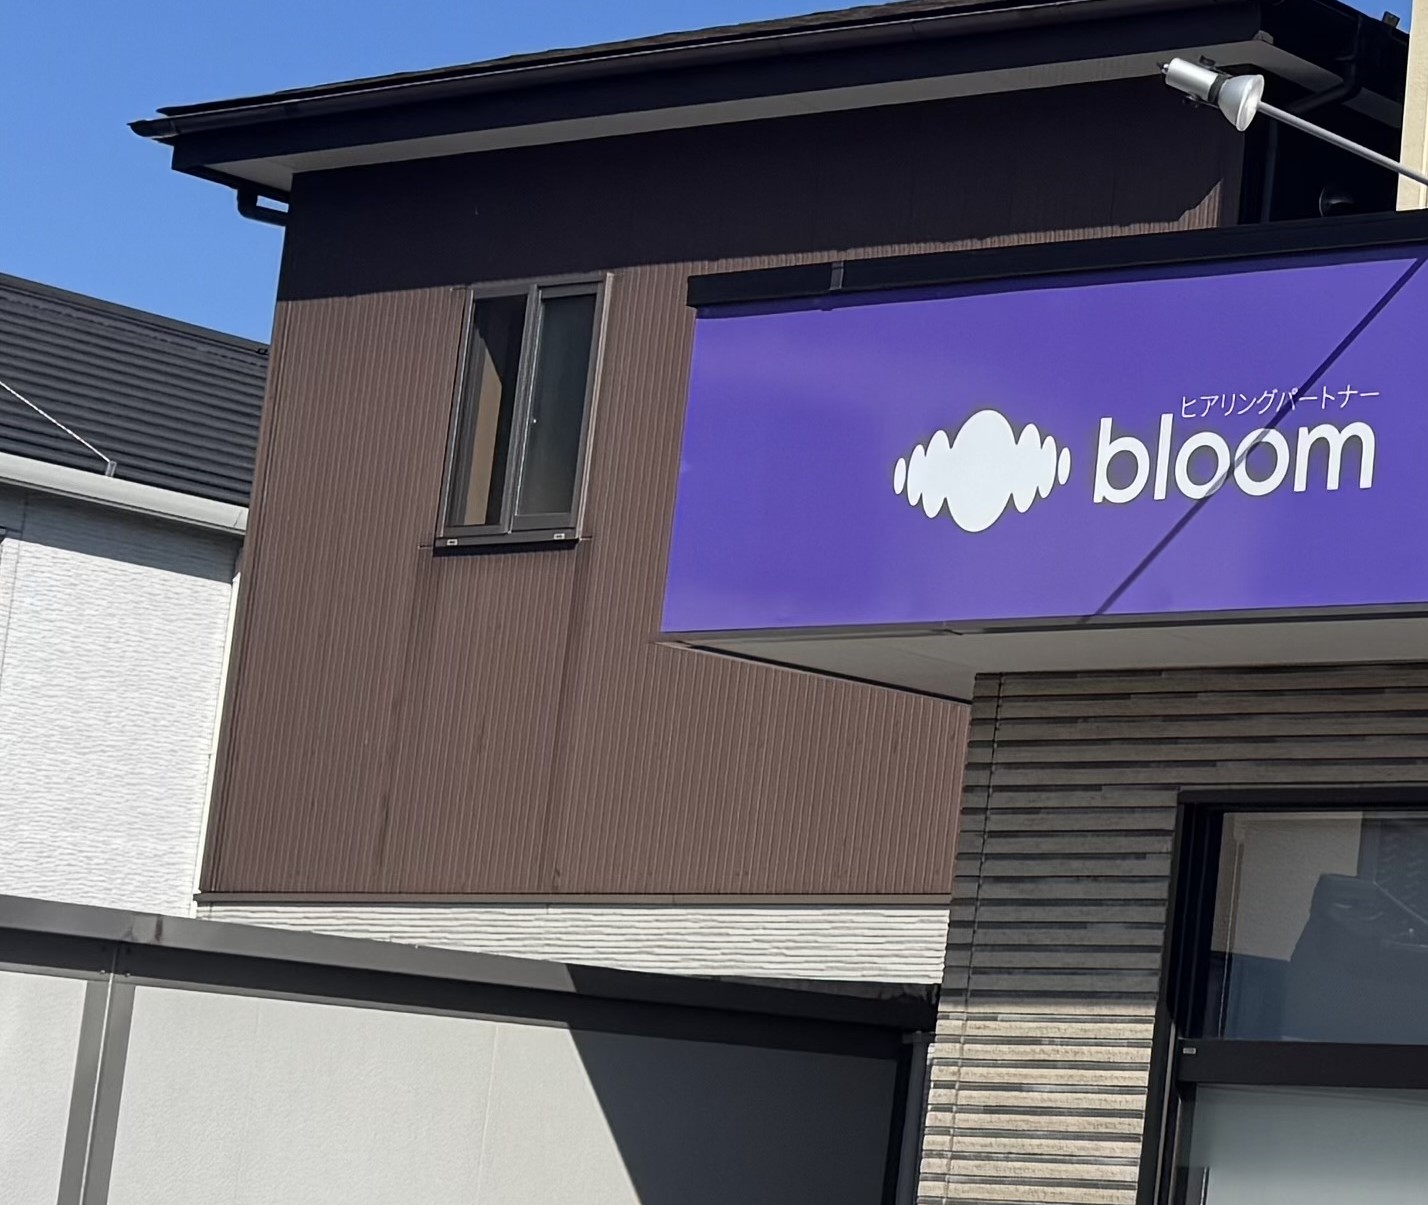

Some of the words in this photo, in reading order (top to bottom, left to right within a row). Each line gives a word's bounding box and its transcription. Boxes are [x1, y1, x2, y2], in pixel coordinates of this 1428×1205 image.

[1181, 384, 1380, 418] ヒアリングパートナー
[1093, 413, 1375, 504] bloom
